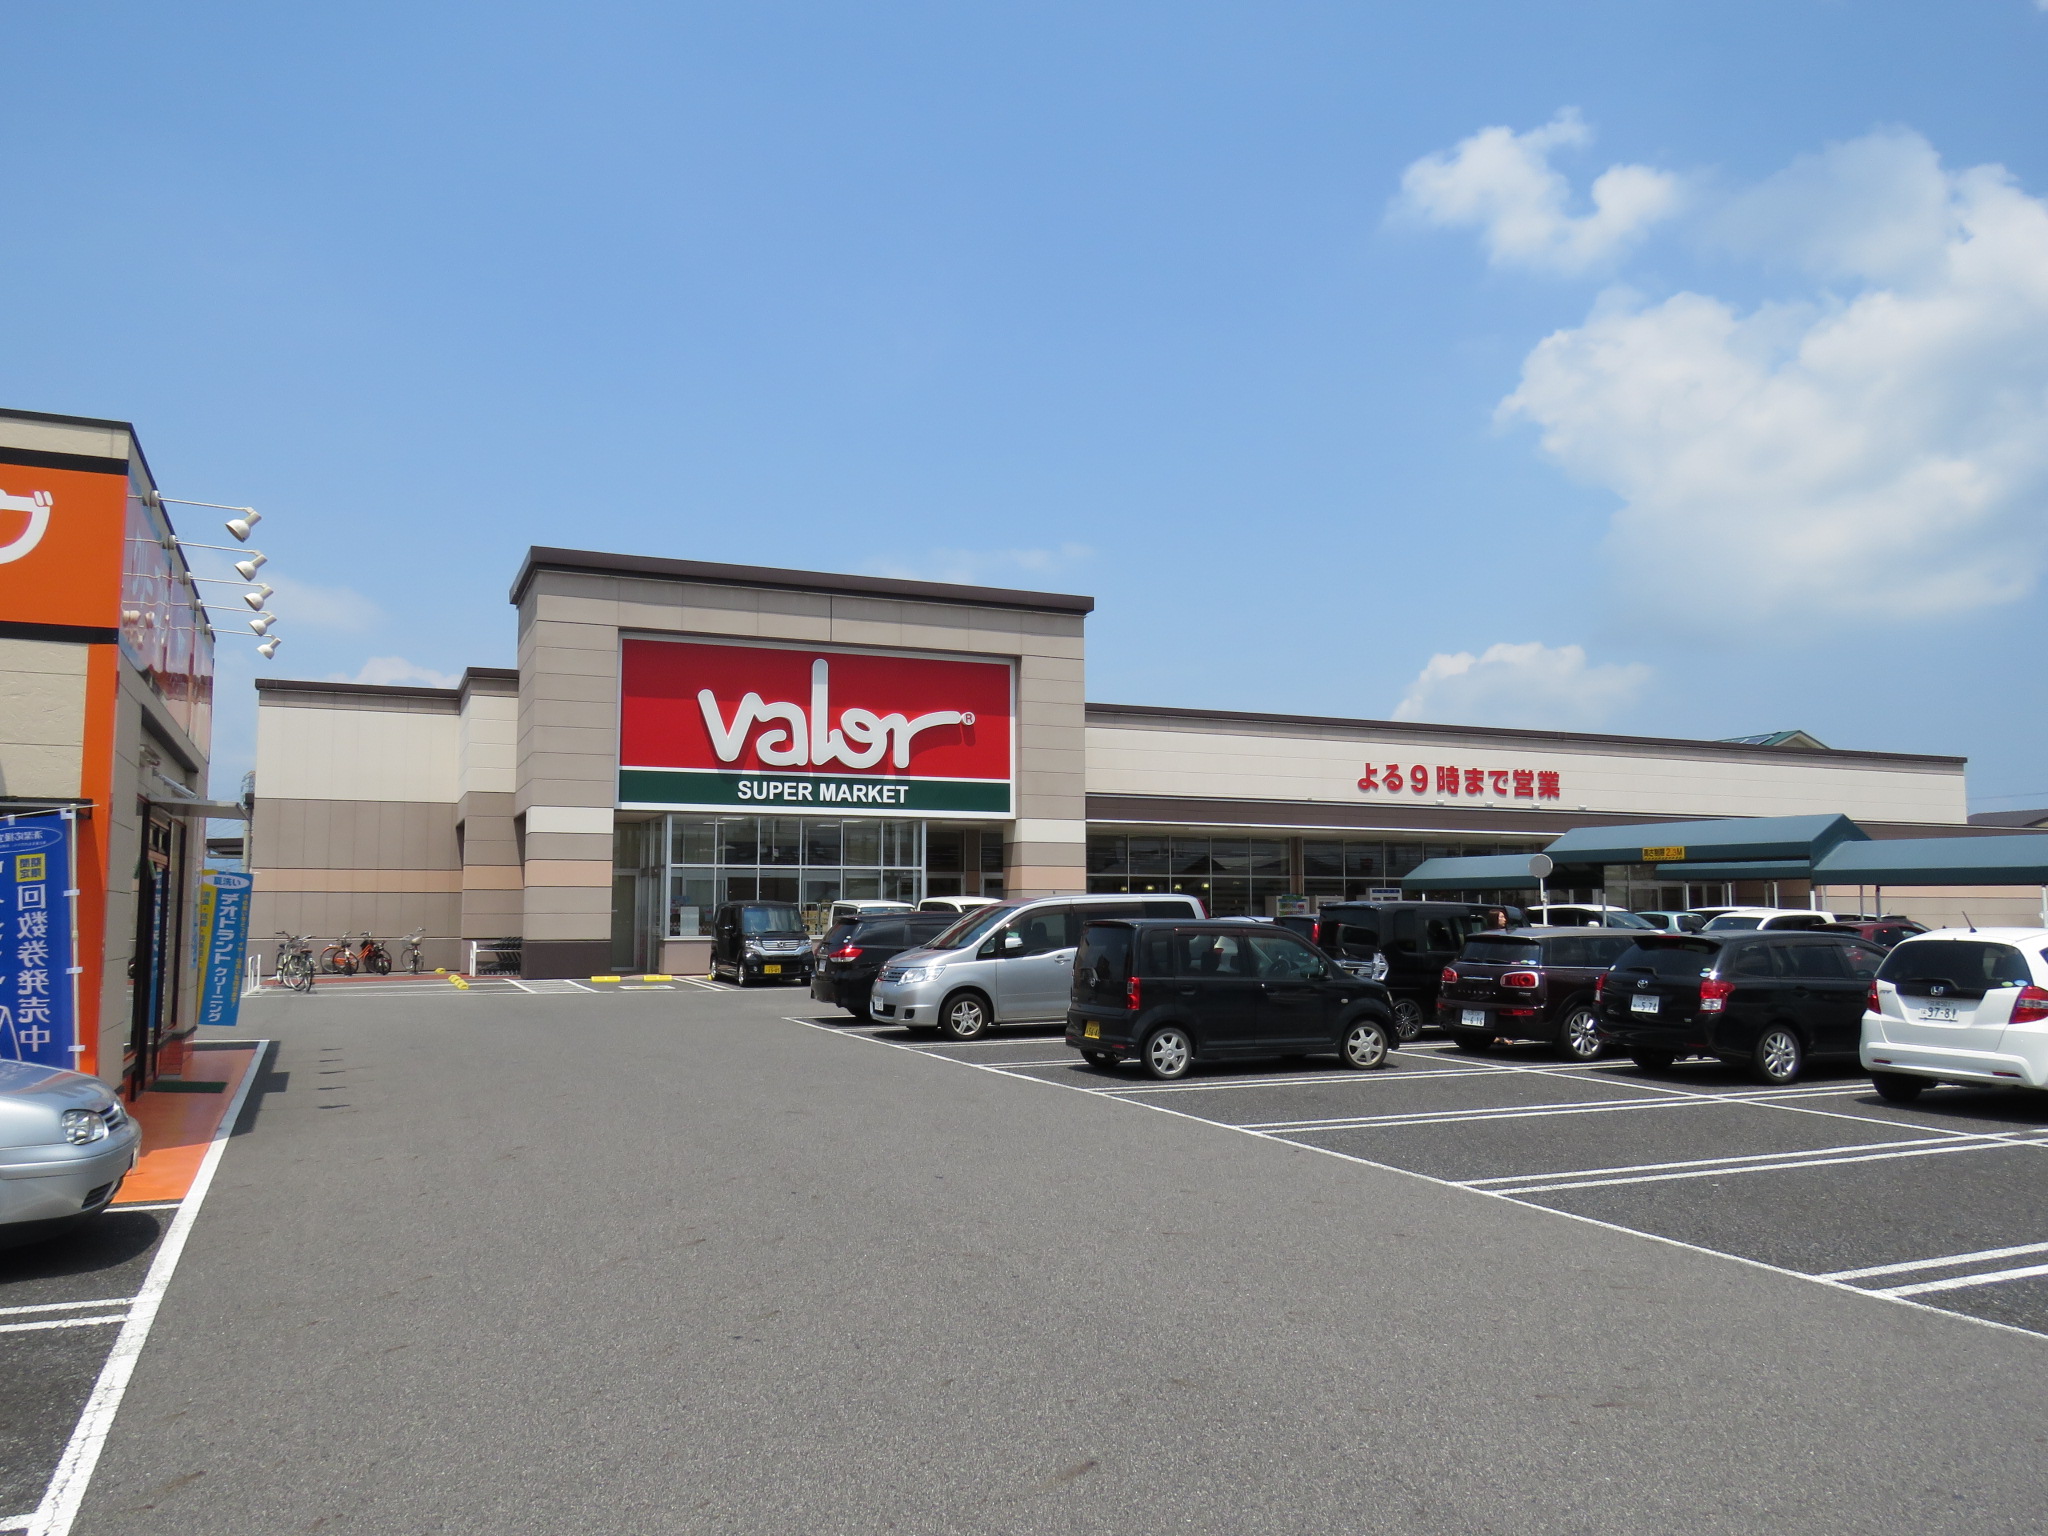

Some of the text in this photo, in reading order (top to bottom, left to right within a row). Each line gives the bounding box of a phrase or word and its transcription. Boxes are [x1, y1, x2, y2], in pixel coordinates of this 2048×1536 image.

[738, 780, 909, 804] SUPER MARKET
[1357, 762, 1560, 798] よる9時まで営業
[208, 893, 239, 1022] デオドラント クリーニング
